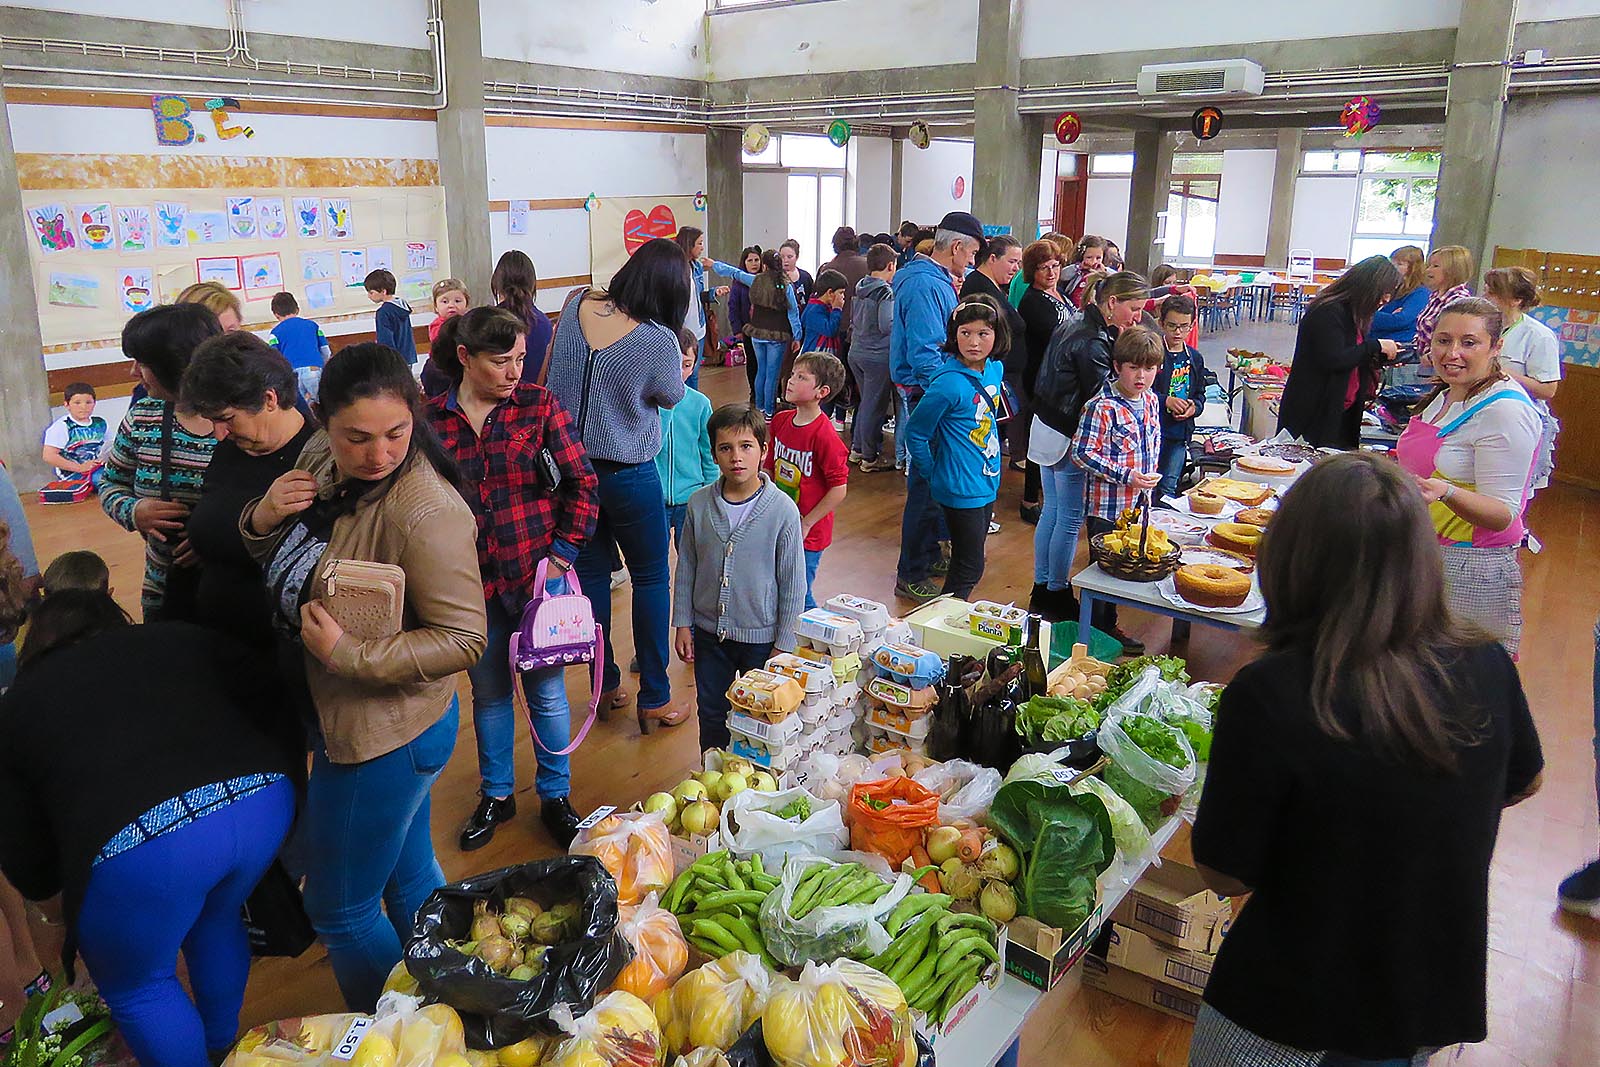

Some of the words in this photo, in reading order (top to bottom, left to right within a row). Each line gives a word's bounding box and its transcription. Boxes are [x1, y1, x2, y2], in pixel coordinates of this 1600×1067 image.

[978, 623, 1003, 637] Planta
[582, 807, 611, 826] 1.50
[339, 1020, 367, 1055] 1.50
